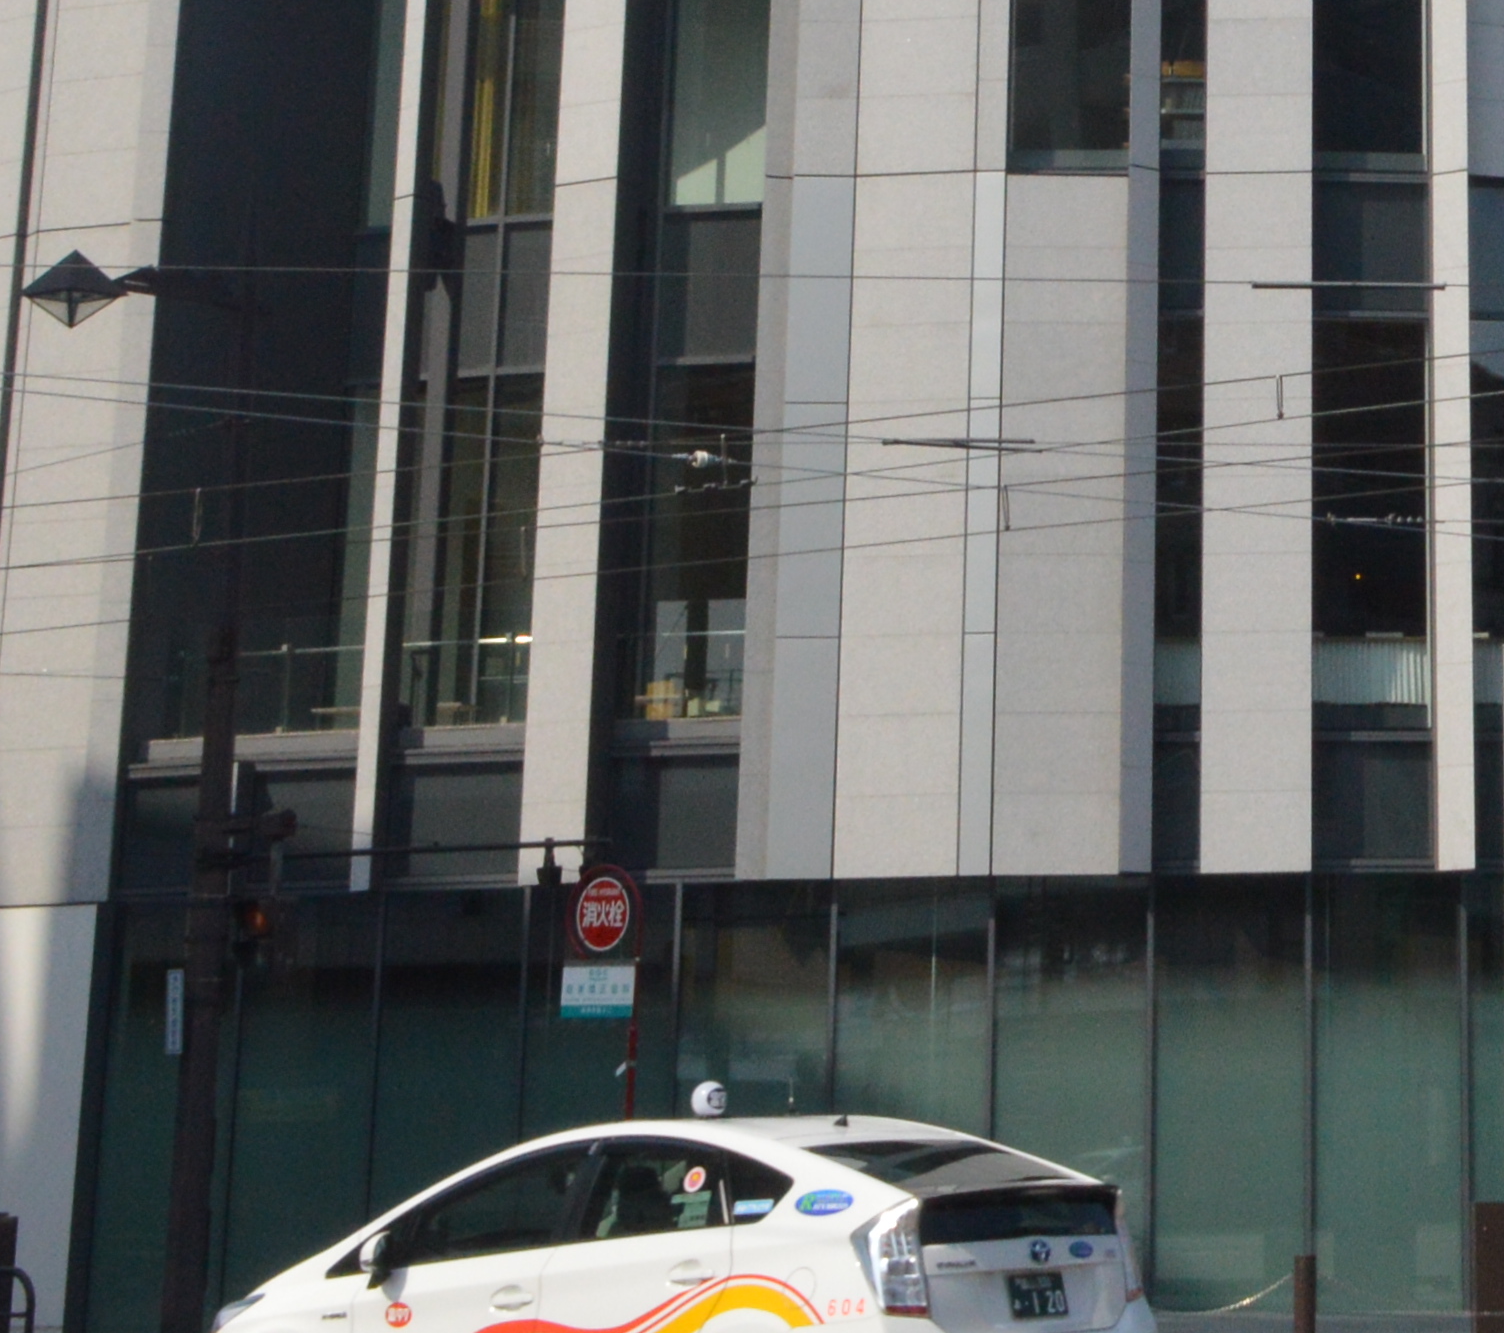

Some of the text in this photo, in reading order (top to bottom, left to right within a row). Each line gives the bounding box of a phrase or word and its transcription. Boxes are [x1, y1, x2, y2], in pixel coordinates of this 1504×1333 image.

[582, 899, 625, 928] 消火栓
[827, 1298, 866, 1317] 604
